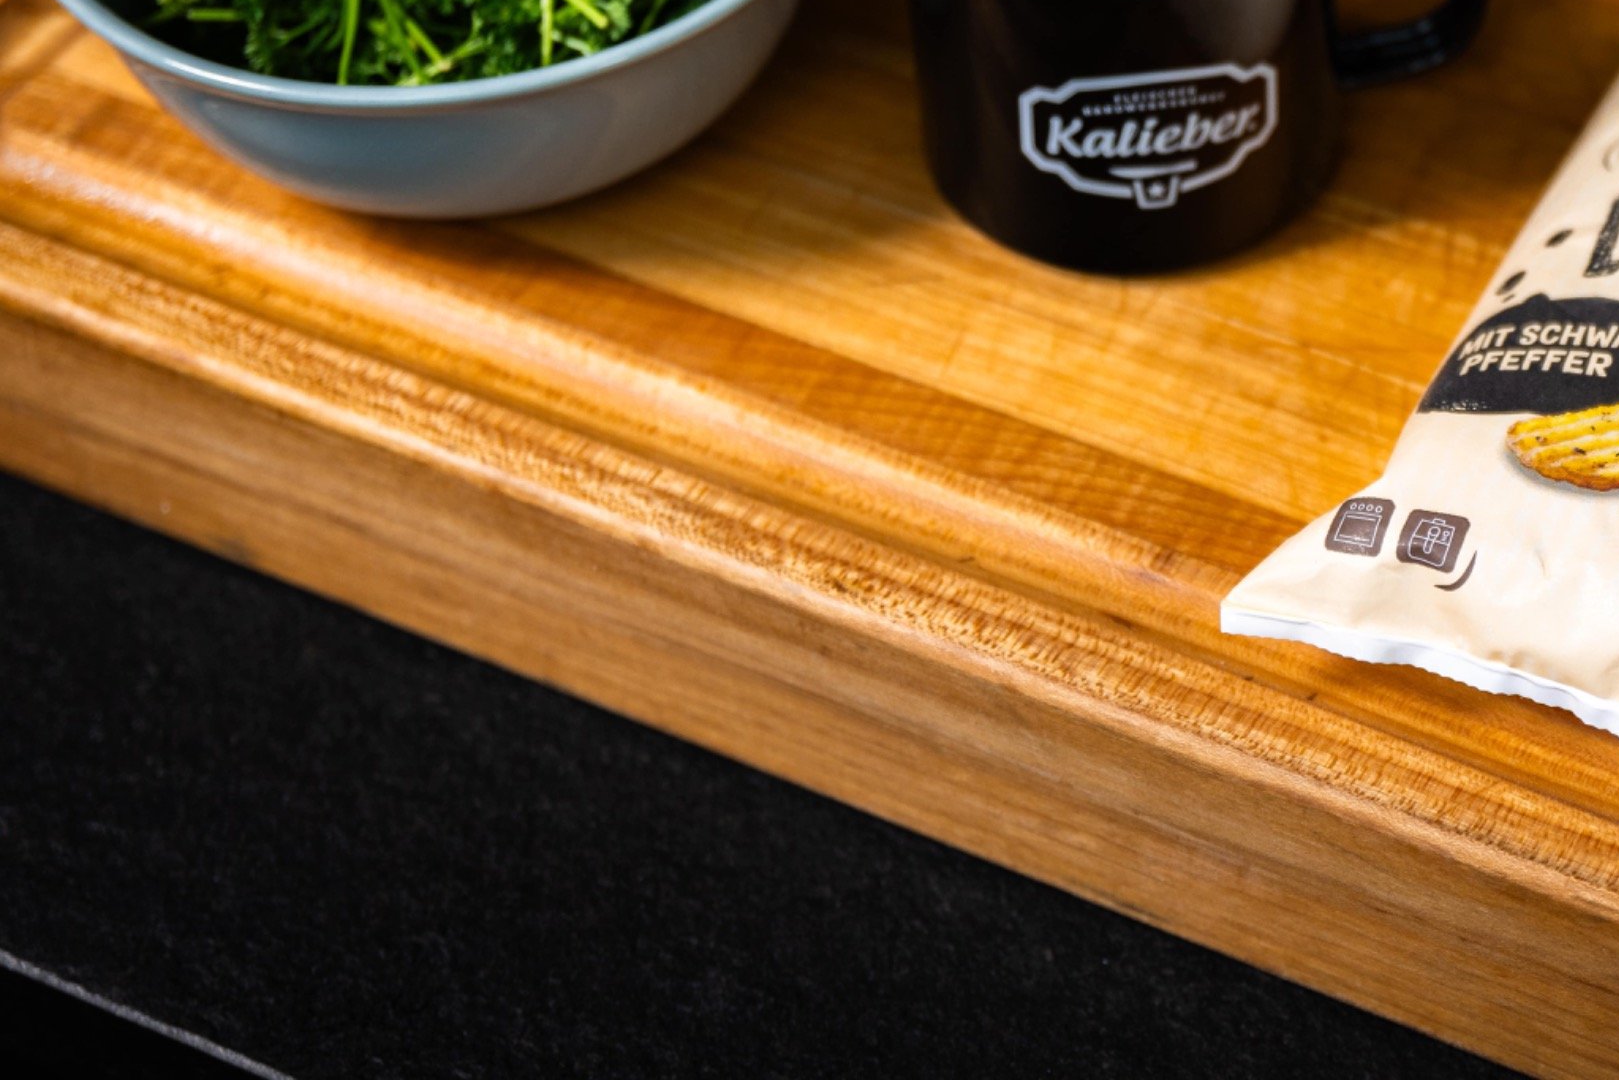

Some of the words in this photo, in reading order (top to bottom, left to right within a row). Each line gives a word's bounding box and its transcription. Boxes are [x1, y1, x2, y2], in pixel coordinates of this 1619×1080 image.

[1046, 104, 1261, 159] Kalieber
[1457, 326, 1515, 361] MIT
[1459, 348, 1615, 378] PFEFFER
